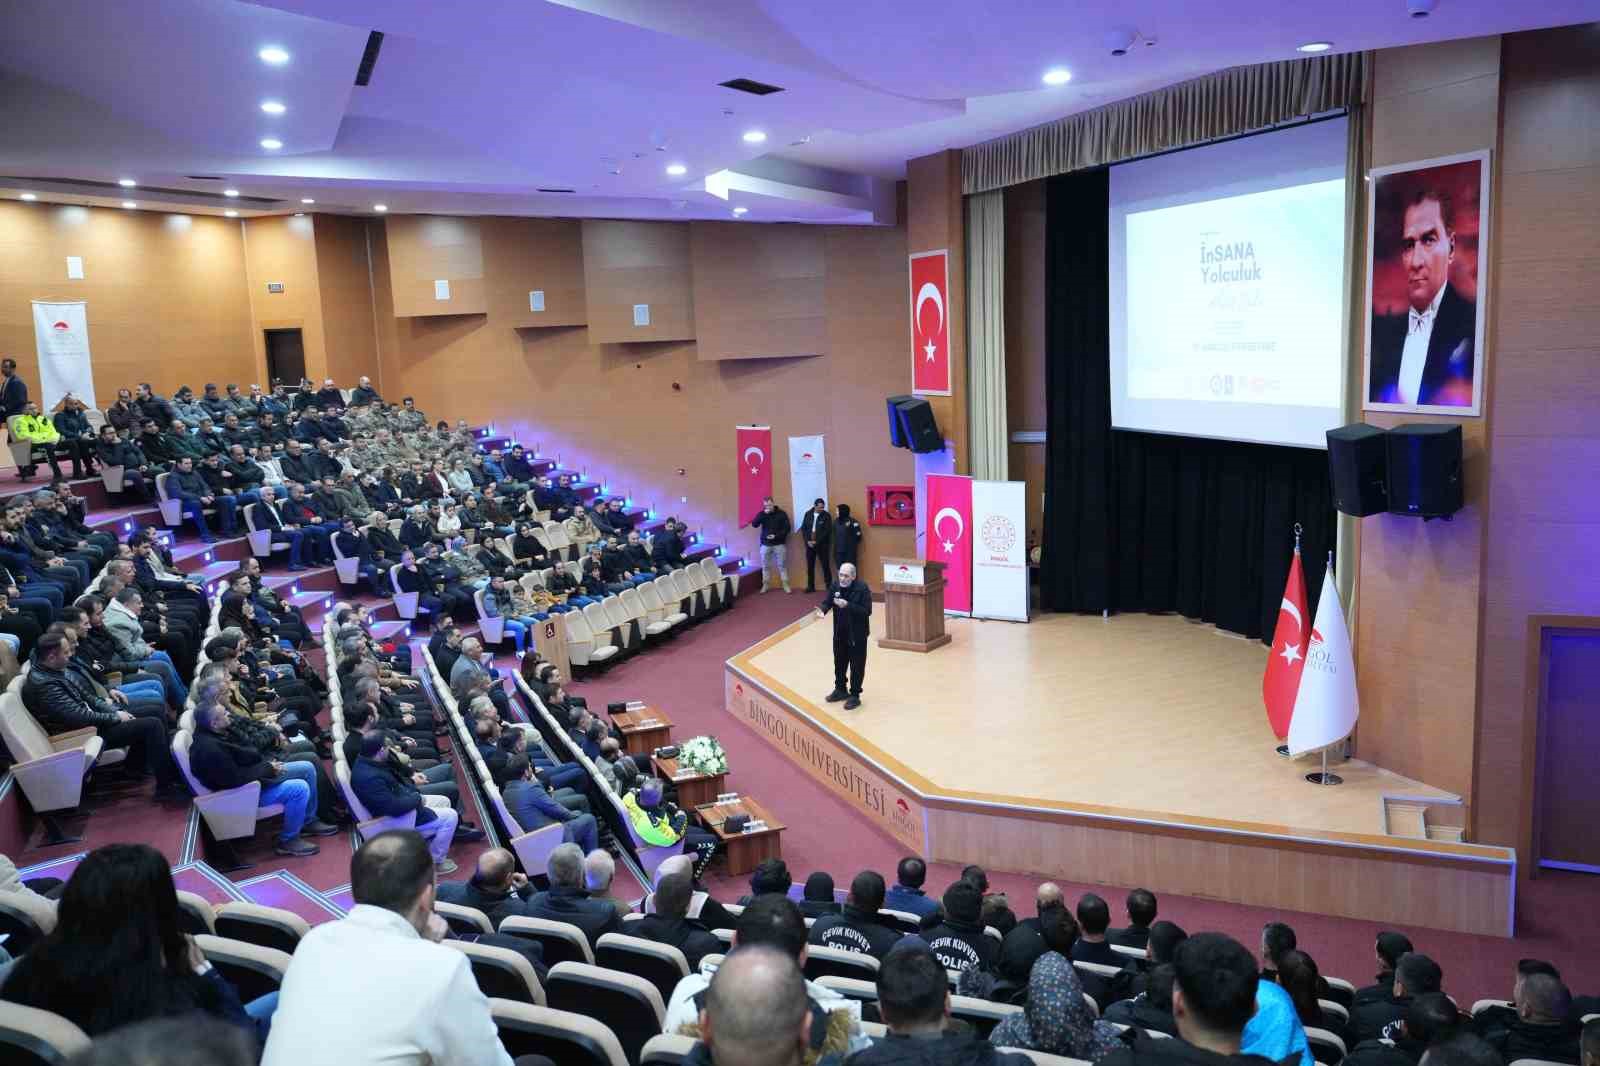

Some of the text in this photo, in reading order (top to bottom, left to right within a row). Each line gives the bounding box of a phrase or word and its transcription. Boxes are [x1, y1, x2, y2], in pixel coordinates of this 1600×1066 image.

[1200, 241, 1255, 264] İnSANA
[1200, 261, 1262, 284] Yolculuk
[793, 727, 886, 817] ÜNİVERSİTESİ
[845, 927, 871, 952] KUVVET
[953, 938, 980, 965] KUVVET
